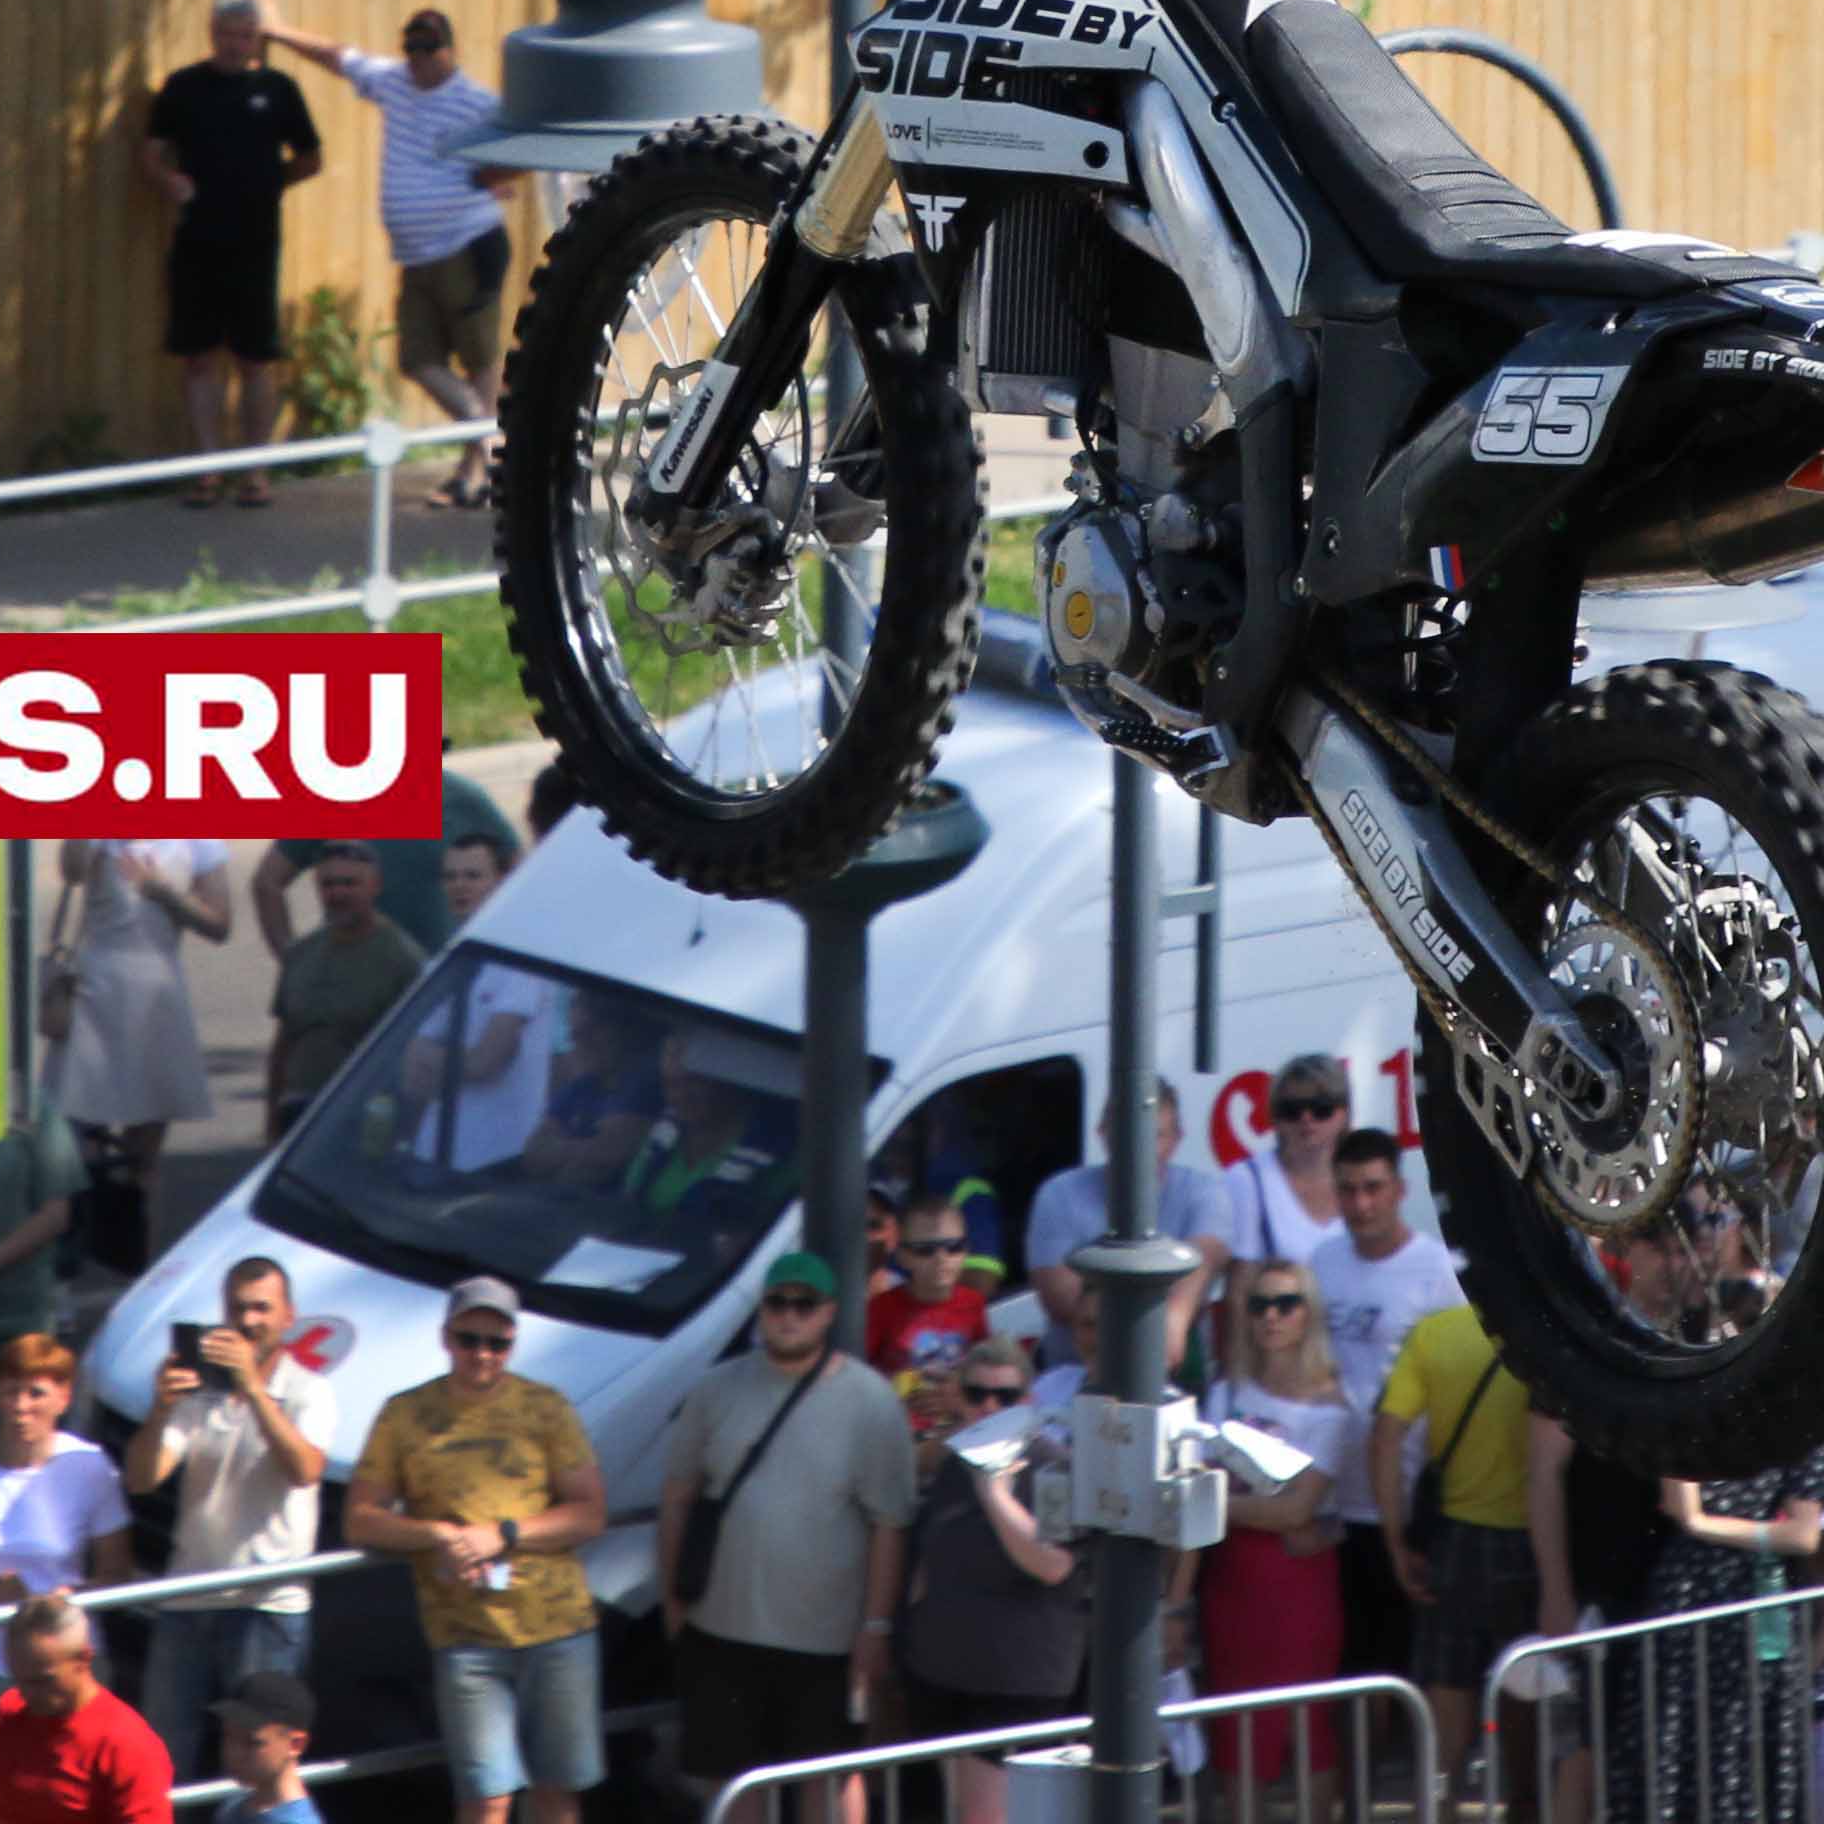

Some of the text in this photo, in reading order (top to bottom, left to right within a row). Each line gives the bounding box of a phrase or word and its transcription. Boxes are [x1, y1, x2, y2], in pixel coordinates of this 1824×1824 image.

[1070, 4, 1154, 49] BY
[856, 27, 1024, 103] SIDE
[1703, 349, 1749, 369] SIDE
[1751, 351, 1786, 371] BY
[1478, 373, 1604, 458] 55
[1340, 790, 1475, 984] SIDE BY SIDE
